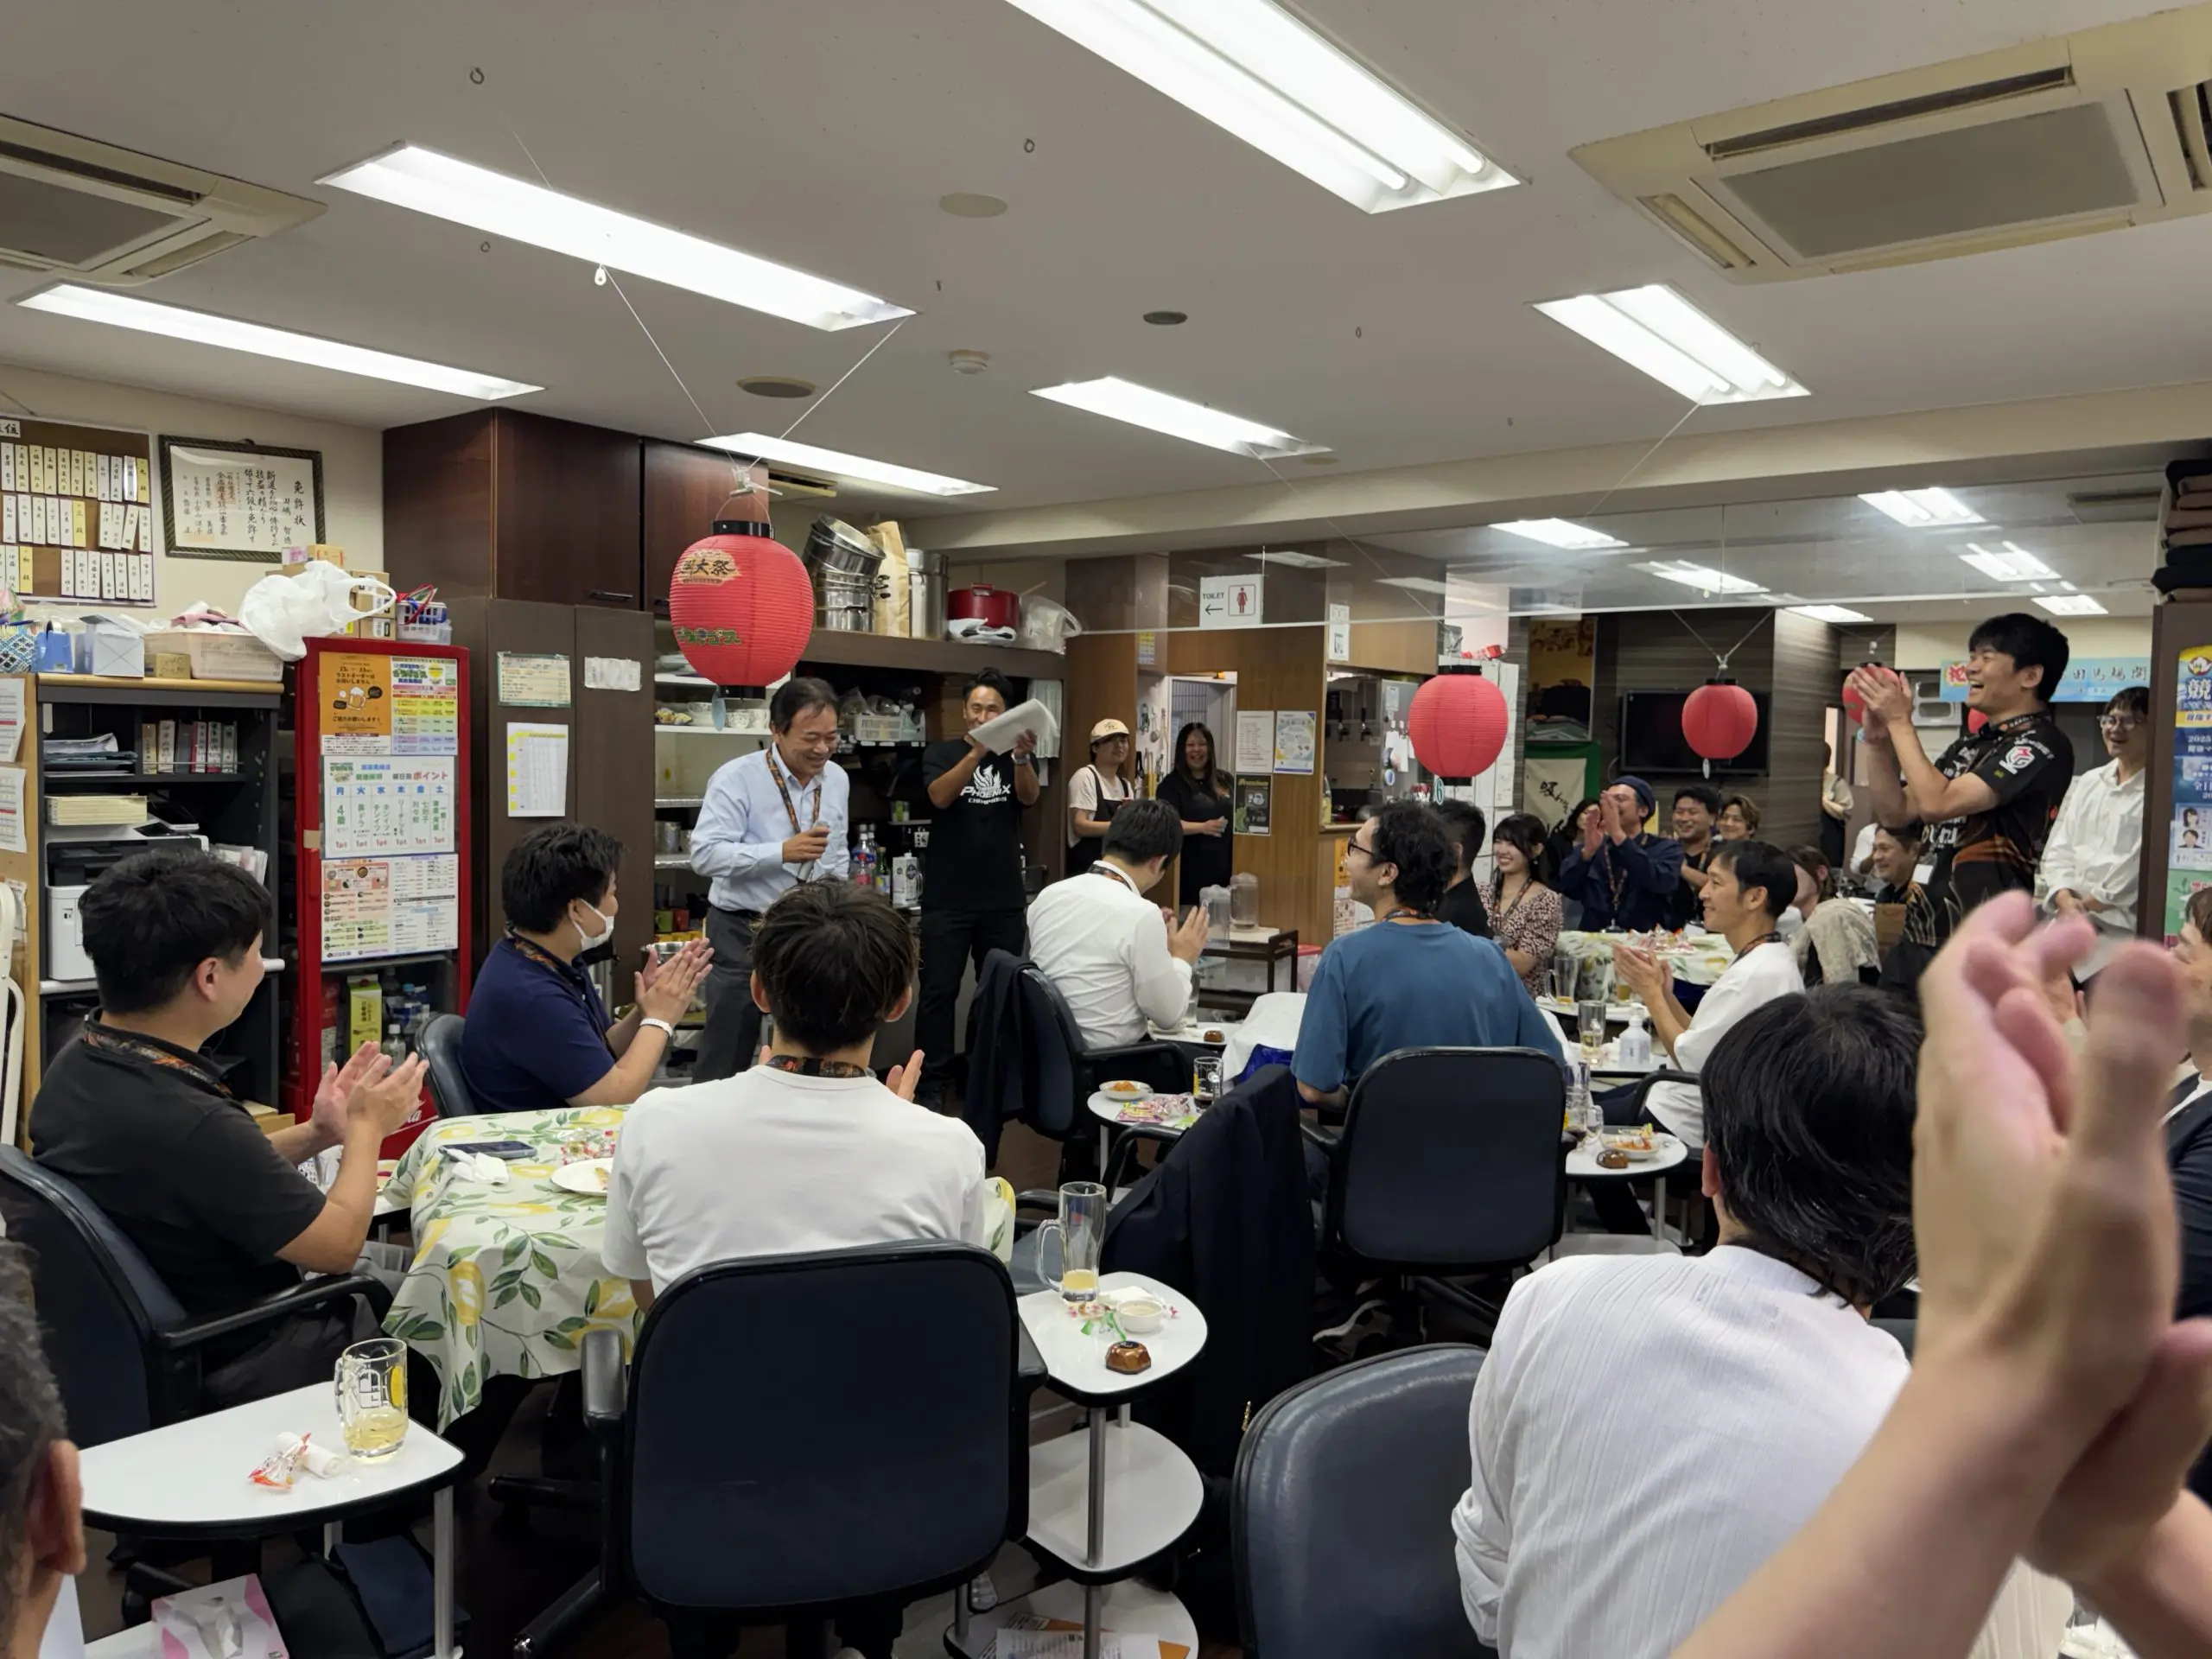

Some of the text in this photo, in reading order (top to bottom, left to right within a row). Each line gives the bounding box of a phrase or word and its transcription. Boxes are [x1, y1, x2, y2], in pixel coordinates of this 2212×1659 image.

[294, 480, 306, 526] 免許状
[336, 787, 344, 796] 月
[357, 786, 365, 795] 火
[377, 785, 385, 794] 水
[397, 785, 405, 794] 木
[436, 785, 444, 793] 土
[960, 784, 1011, 798] PHOENIX
